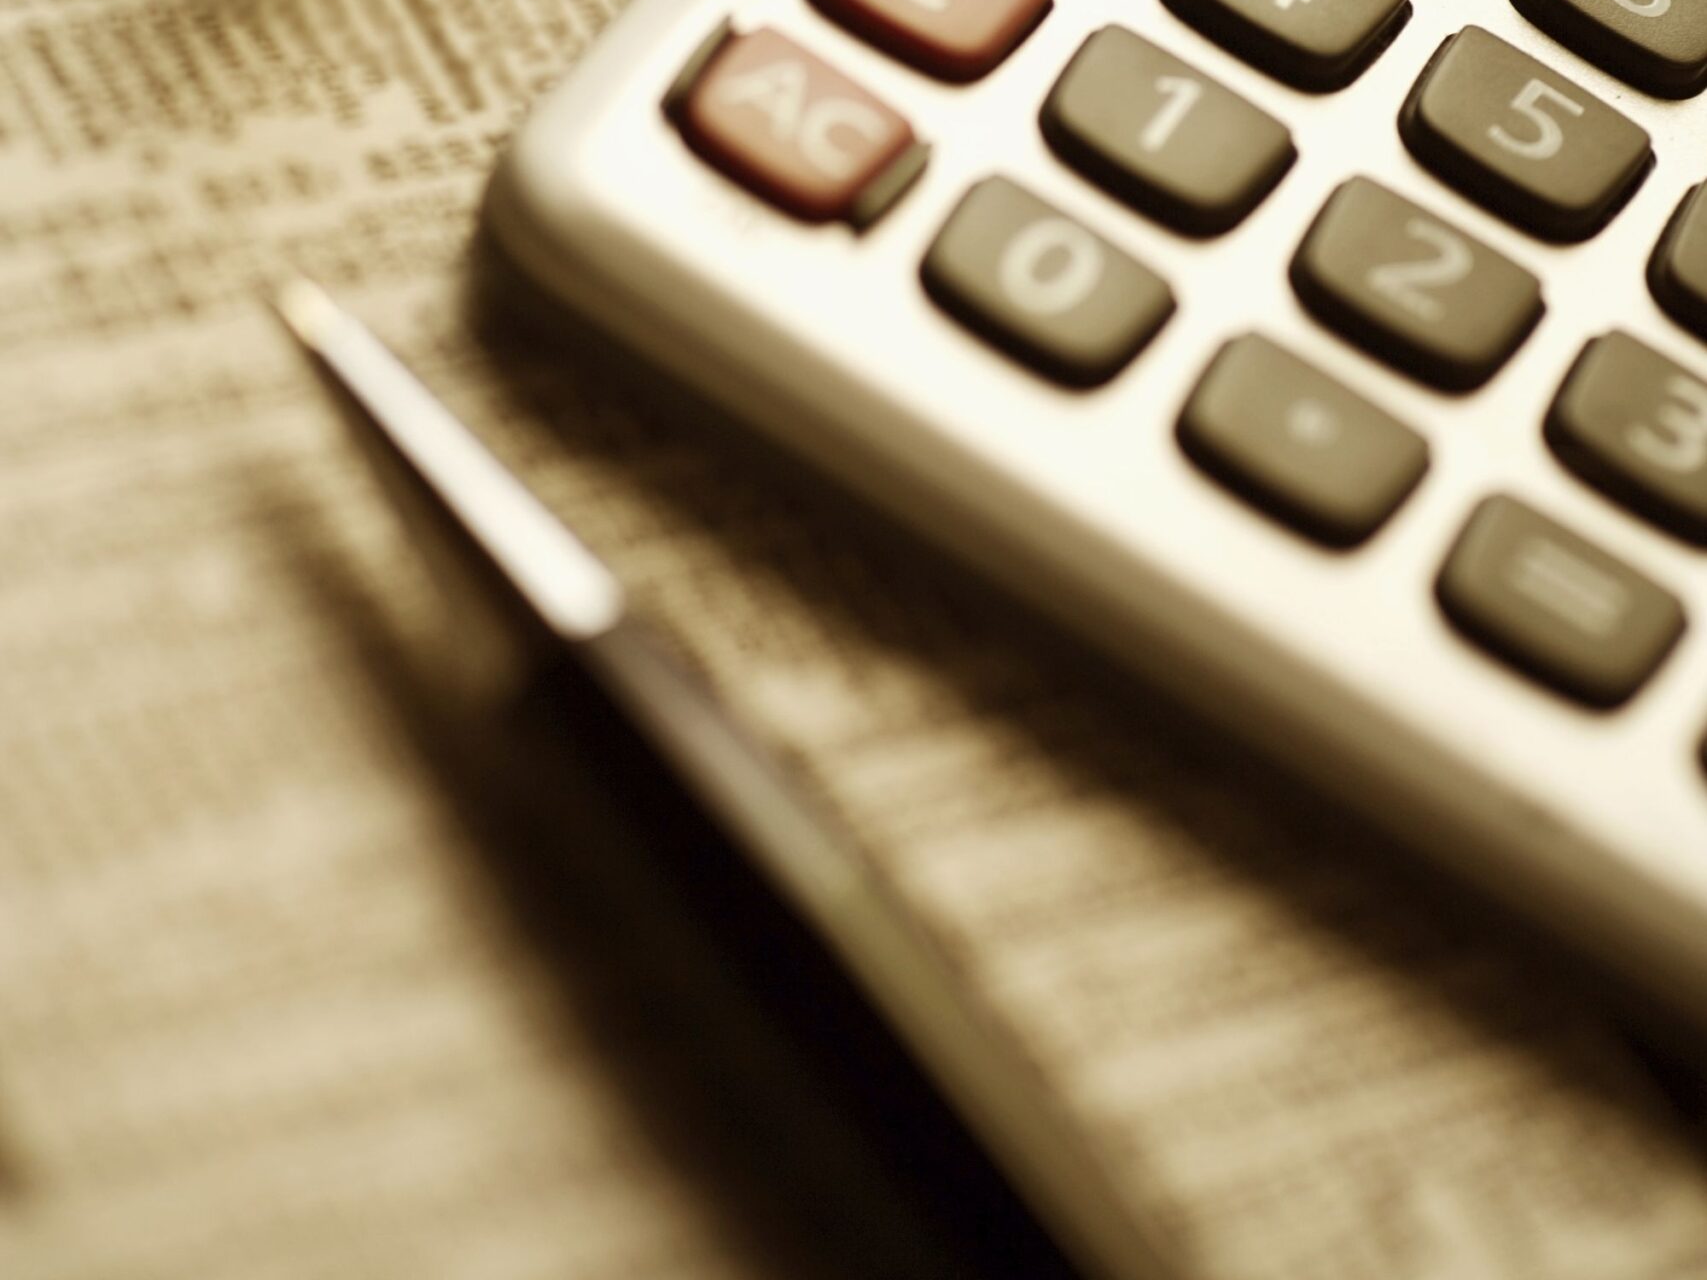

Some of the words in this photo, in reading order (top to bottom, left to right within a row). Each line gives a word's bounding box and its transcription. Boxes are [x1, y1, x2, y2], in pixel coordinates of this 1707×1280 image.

[717, 57, 894, 181] AC
[1138, 75, 1205, 153] 1
[1487, 79, 1584, 160] 5
[1002, 218, 1103, 317] 0
[1366, 218, 1476, 319] 2
[1624, 373, 1707, 473] 3
